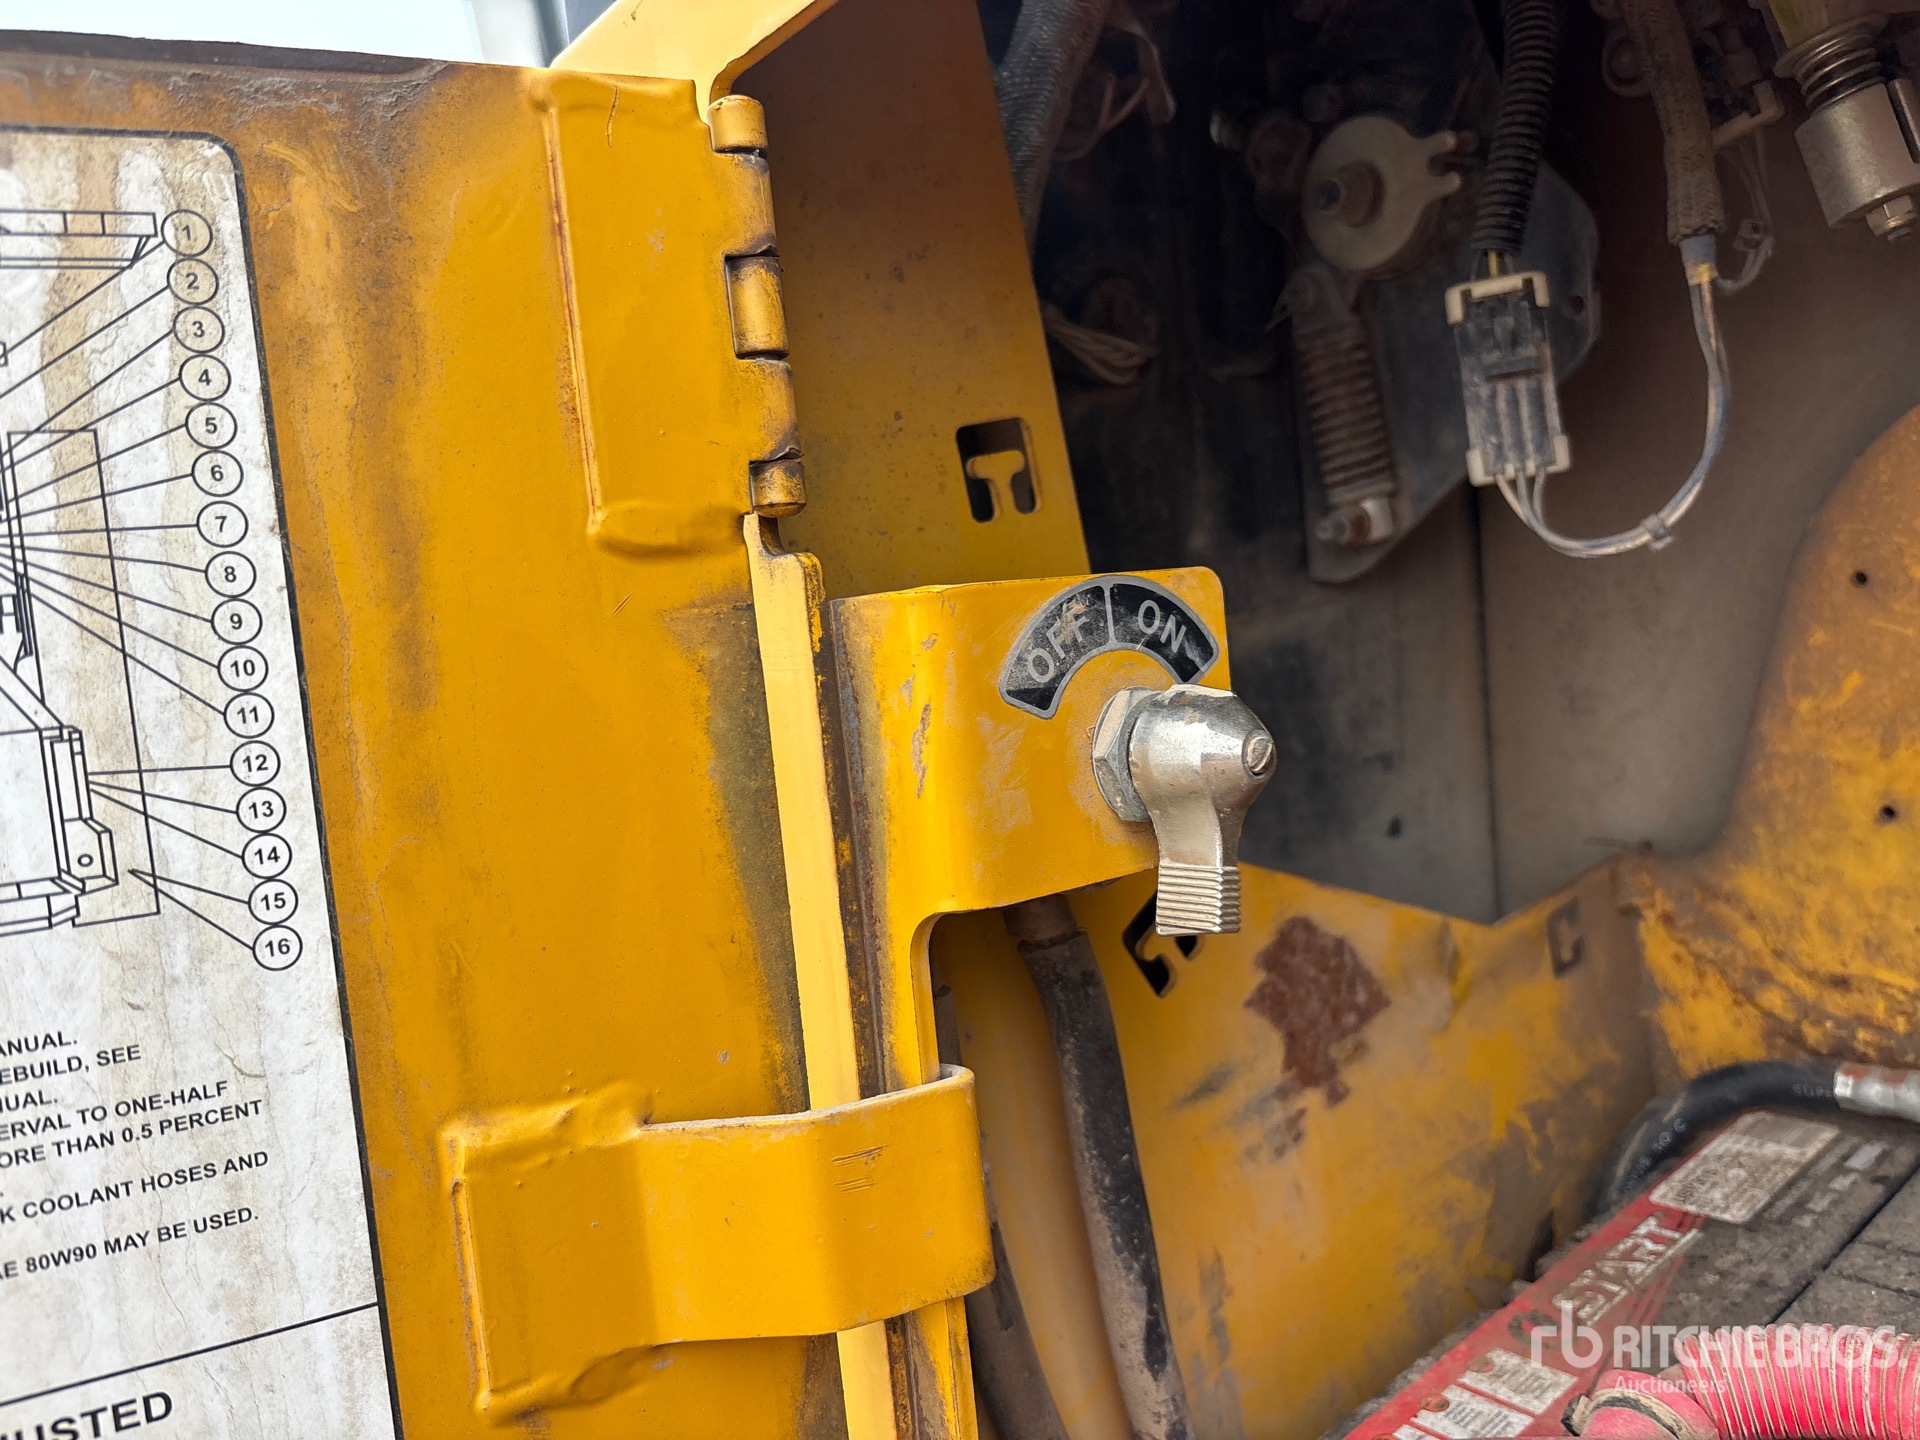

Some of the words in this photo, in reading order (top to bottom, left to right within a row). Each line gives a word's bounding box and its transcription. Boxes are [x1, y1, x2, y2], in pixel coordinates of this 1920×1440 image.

[183, 225, 190, 241] 1
[186, 272, 199, 290] 2
[193, 320, 204, 338] 3
[199, 368, 211, 386] 4
[206, 417, 217, 434] 5
[211, 464, 223, 482] 6
[215, 514, 227, 533] 7
[224, 565, 237, 583] 8
[230, 613, 243, 630] 9
[1027, 601, 1090, 683] OFF
[1138, 599, 1187, 654] ON
[231, 659, 256, 679] 10
[237, 706, 260, 725] 11
[243, 754, 269, 774] 12
[248, 800, 274, 820] 13
[254, 846, 280, 866] 14
[260, 892, 286, 912] 15
[265, 938, 291, 957] 16
[96, 1045, 141, 1067] SEE
[0, 1089, 58, 1113] UAL.
[77, 1106, 108, 1126] TO
[114, 1080, 229, 1118] ONE-HALF
[52, 1130, 115, 1159] THAN
[122, 1124, 153, 1144] 0.5
[159, 1099, 264, 1136] PERCENT
[23, 1180, 134, 1219] COOLANT
[141, 1163, 218, 1193] HOSES
[223, 1151, 269, 1175] AND
[0, 1260, 18, 1281] E
[26, 1243, 97, 1273] 80W90
[103, 1231, 151, 1255] MAY
[158, 1222, 188, 1243] BE
[193, 1206, 259, 1235] USED.
